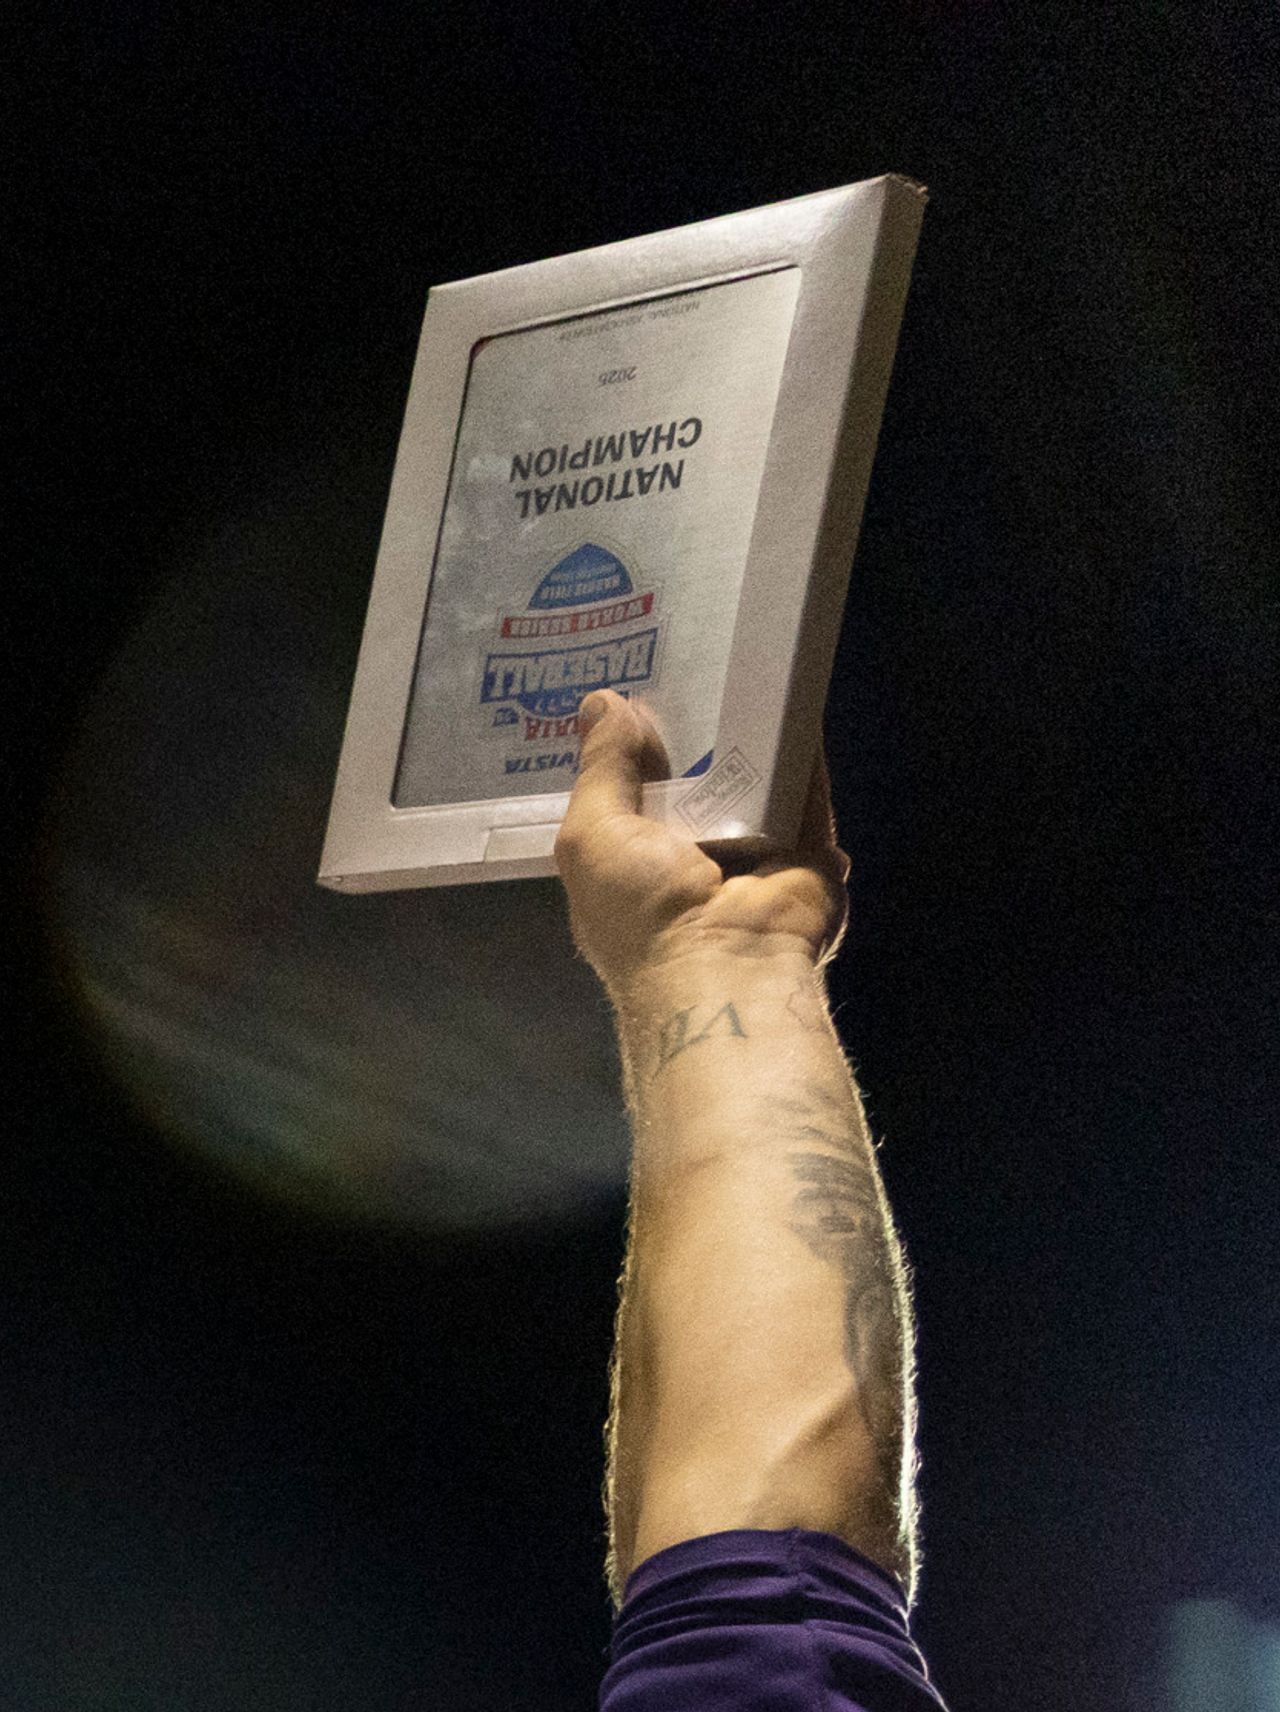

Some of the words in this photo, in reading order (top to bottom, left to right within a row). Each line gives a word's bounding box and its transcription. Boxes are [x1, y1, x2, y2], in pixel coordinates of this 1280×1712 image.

[597, 366, 638, 387] 2025
[510, 417, 702, 483] CHAMPION
[515, 459, 684, 518] NATIONAL
[491, 641, 650, 697] BASEBALL
[503, 751, 581, 774] VISTA
